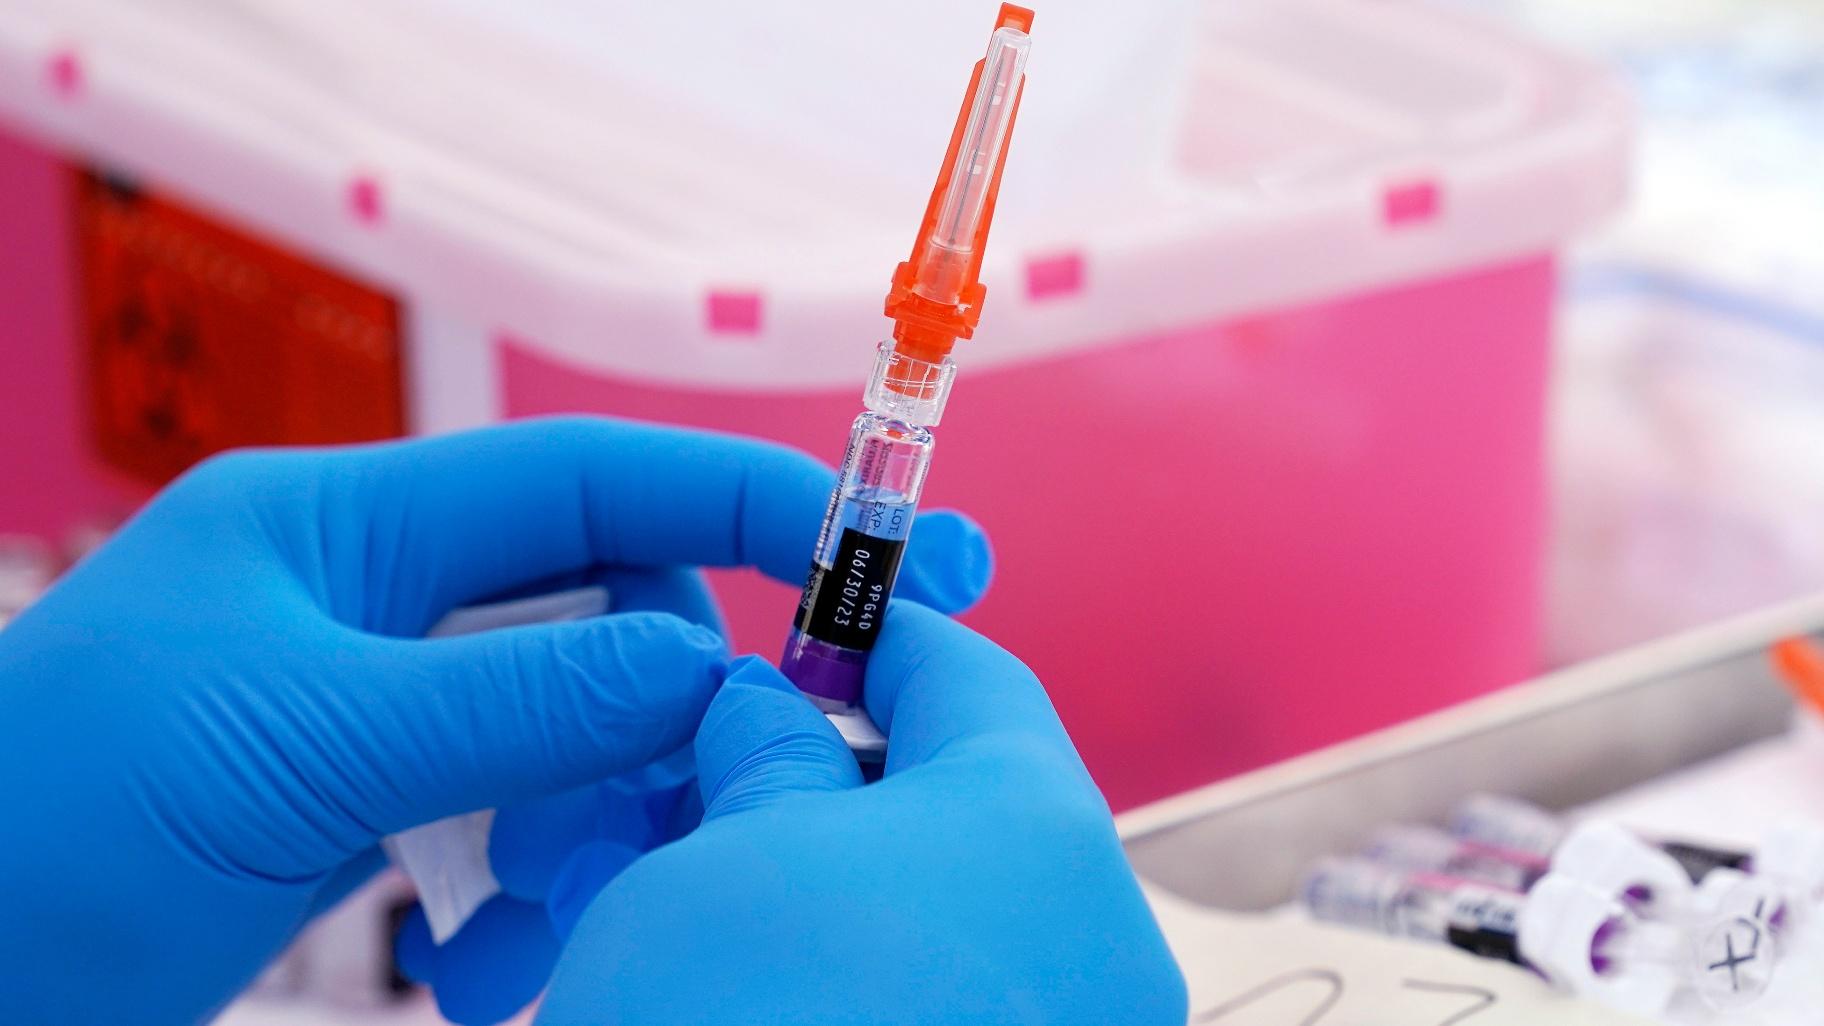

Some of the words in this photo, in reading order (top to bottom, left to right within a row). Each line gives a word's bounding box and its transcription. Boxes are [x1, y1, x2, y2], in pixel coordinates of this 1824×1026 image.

[868, 501, 887, 531] EXP:
[888, 508, 905, 535] LOT:
[834, 549, 870, 626] 06/30/23
[858, 584, 883, 630] 9PG4D
